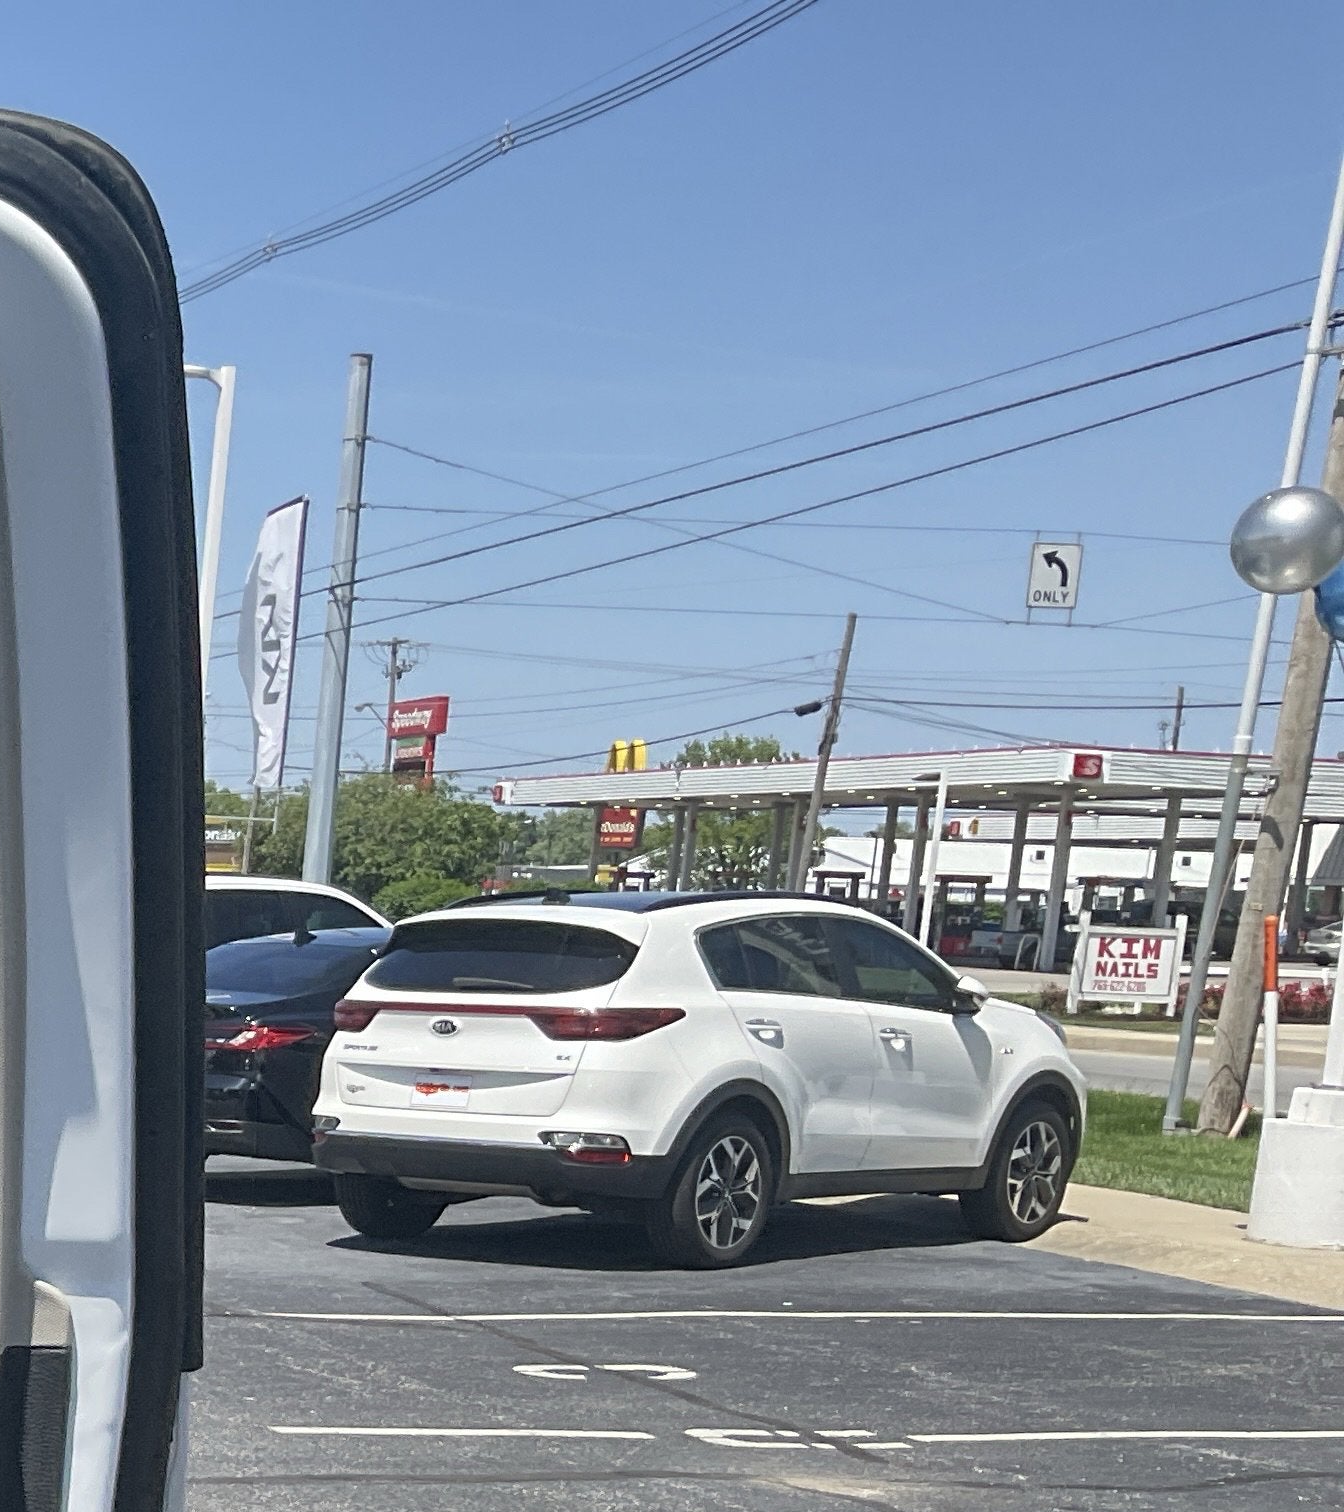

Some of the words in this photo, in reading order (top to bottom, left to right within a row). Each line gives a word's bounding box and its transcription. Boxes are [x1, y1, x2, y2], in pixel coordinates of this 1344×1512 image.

[1032, 589, 1070, 603] ONLY
[1097, 937, 1163, 960] KIM
[1094, 960, 1159, 979] NAILS
